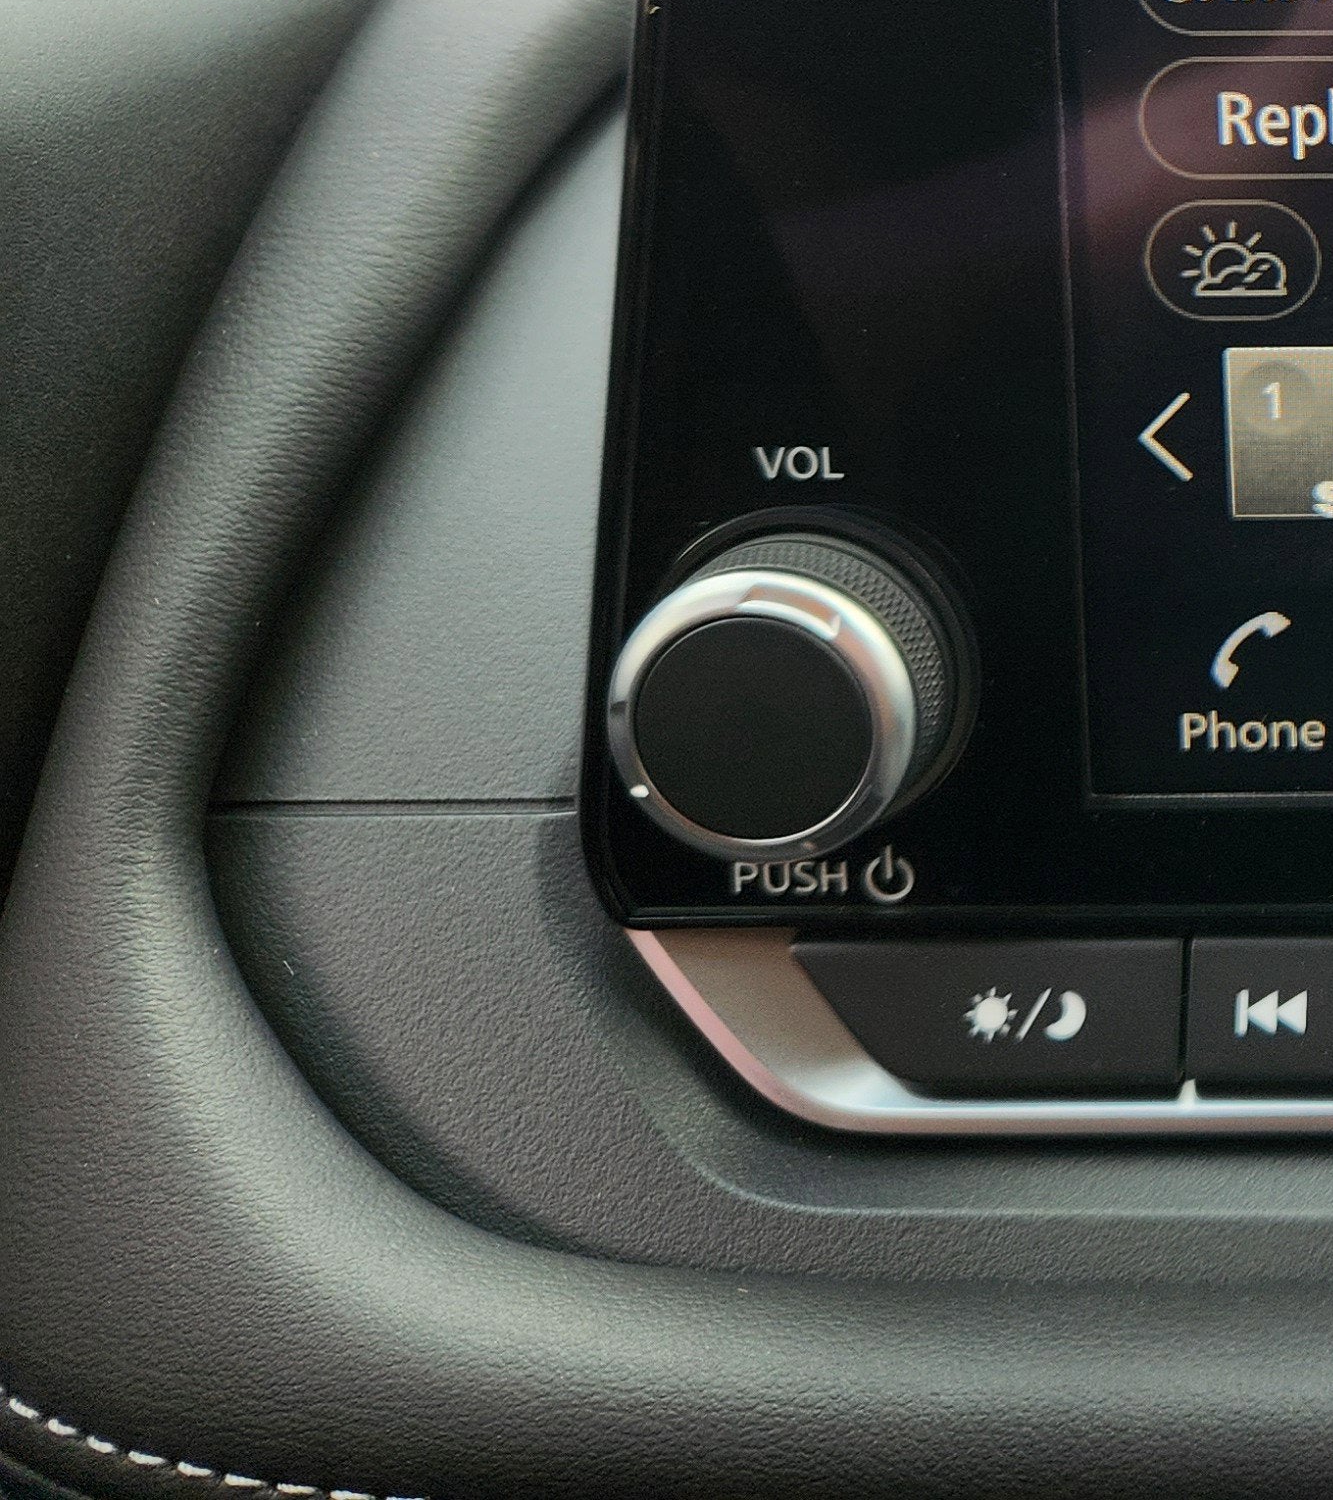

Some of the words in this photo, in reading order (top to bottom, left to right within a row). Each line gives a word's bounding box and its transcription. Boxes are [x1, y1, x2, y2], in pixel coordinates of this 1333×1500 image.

[1263, 382, 1284, 419] 1
[754, 446, 844, 480] VOL
[1180, 710, 1326, 752] Phone
[733, 861, 848, 894] PUSH
